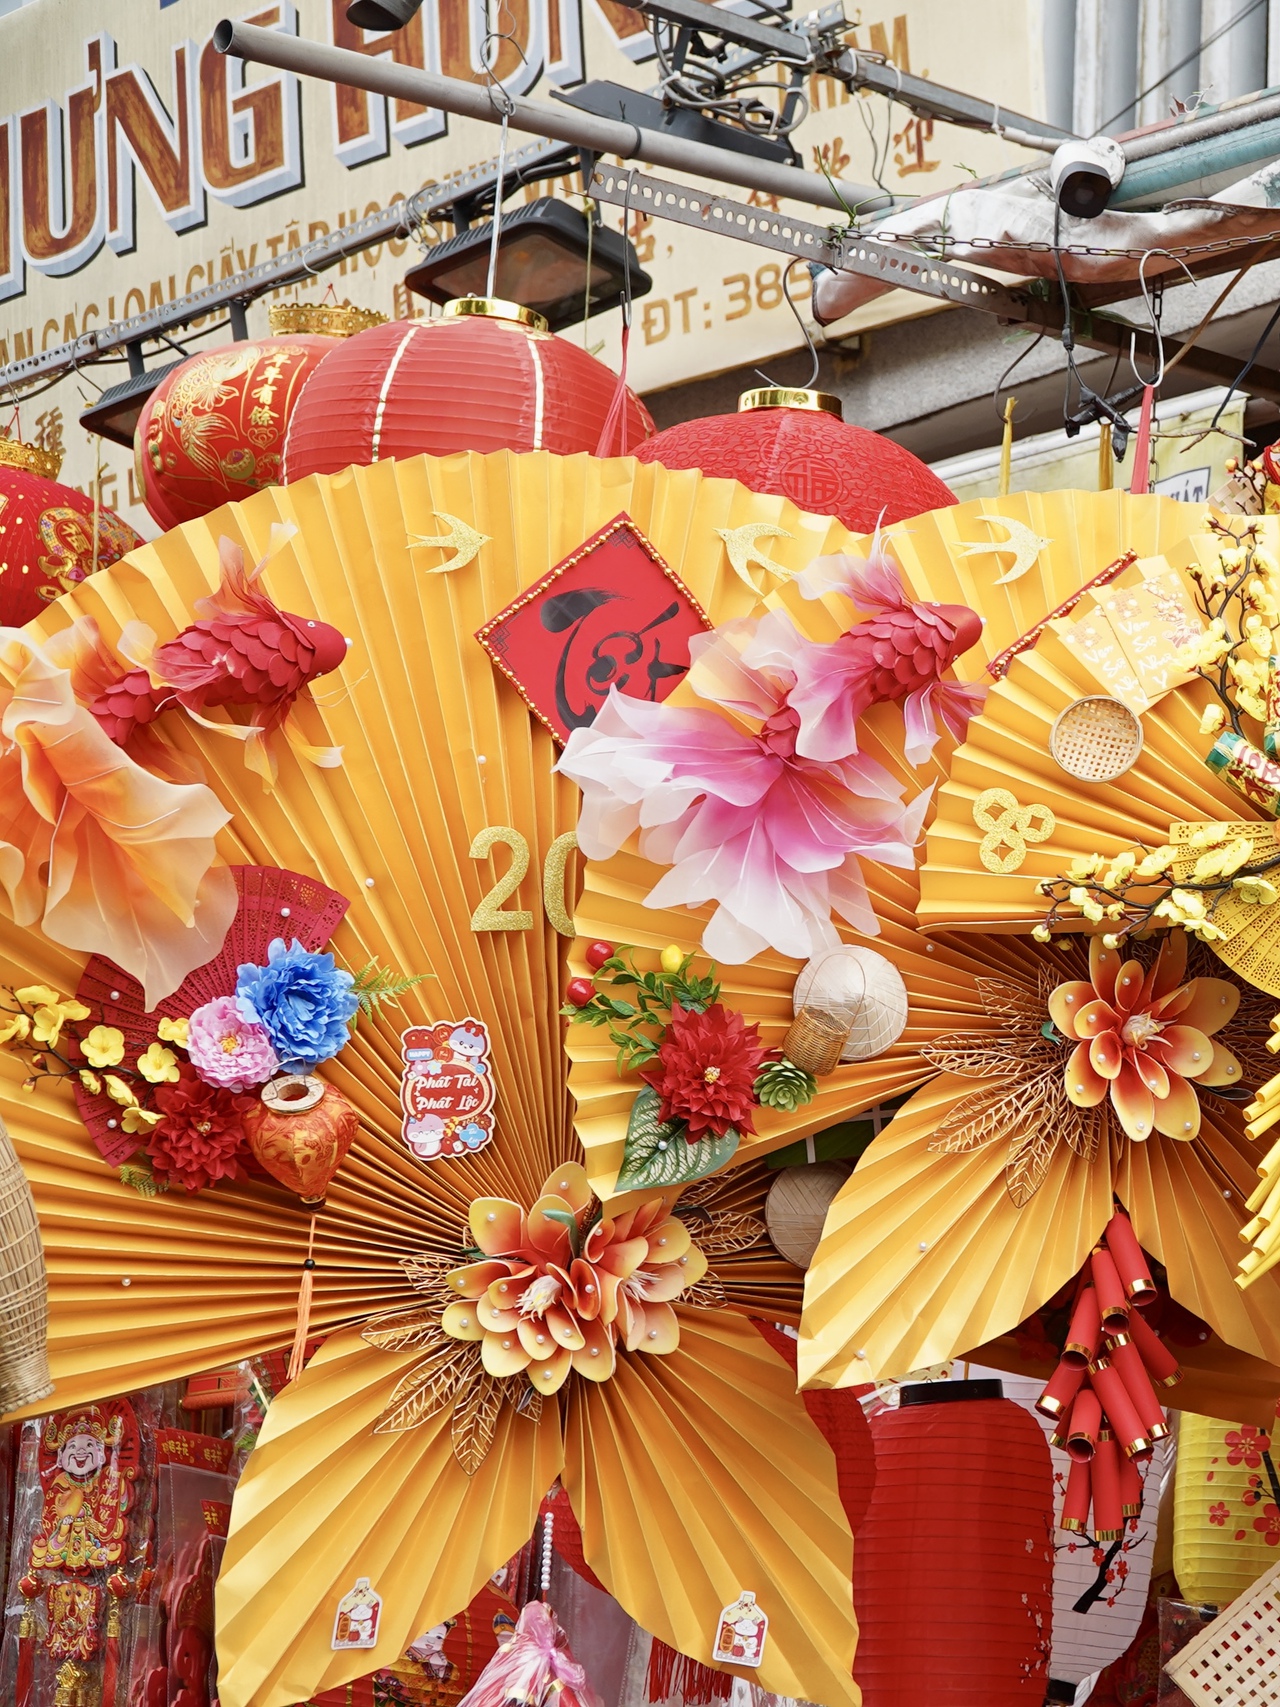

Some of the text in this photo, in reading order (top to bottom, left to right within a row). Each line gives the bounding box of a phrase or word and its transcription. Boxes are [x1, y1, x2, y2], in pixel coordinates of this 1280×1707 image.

[0, 0, 304, 302] ƯNG
[416, 1095, 480, 1111] Phát Lộc
